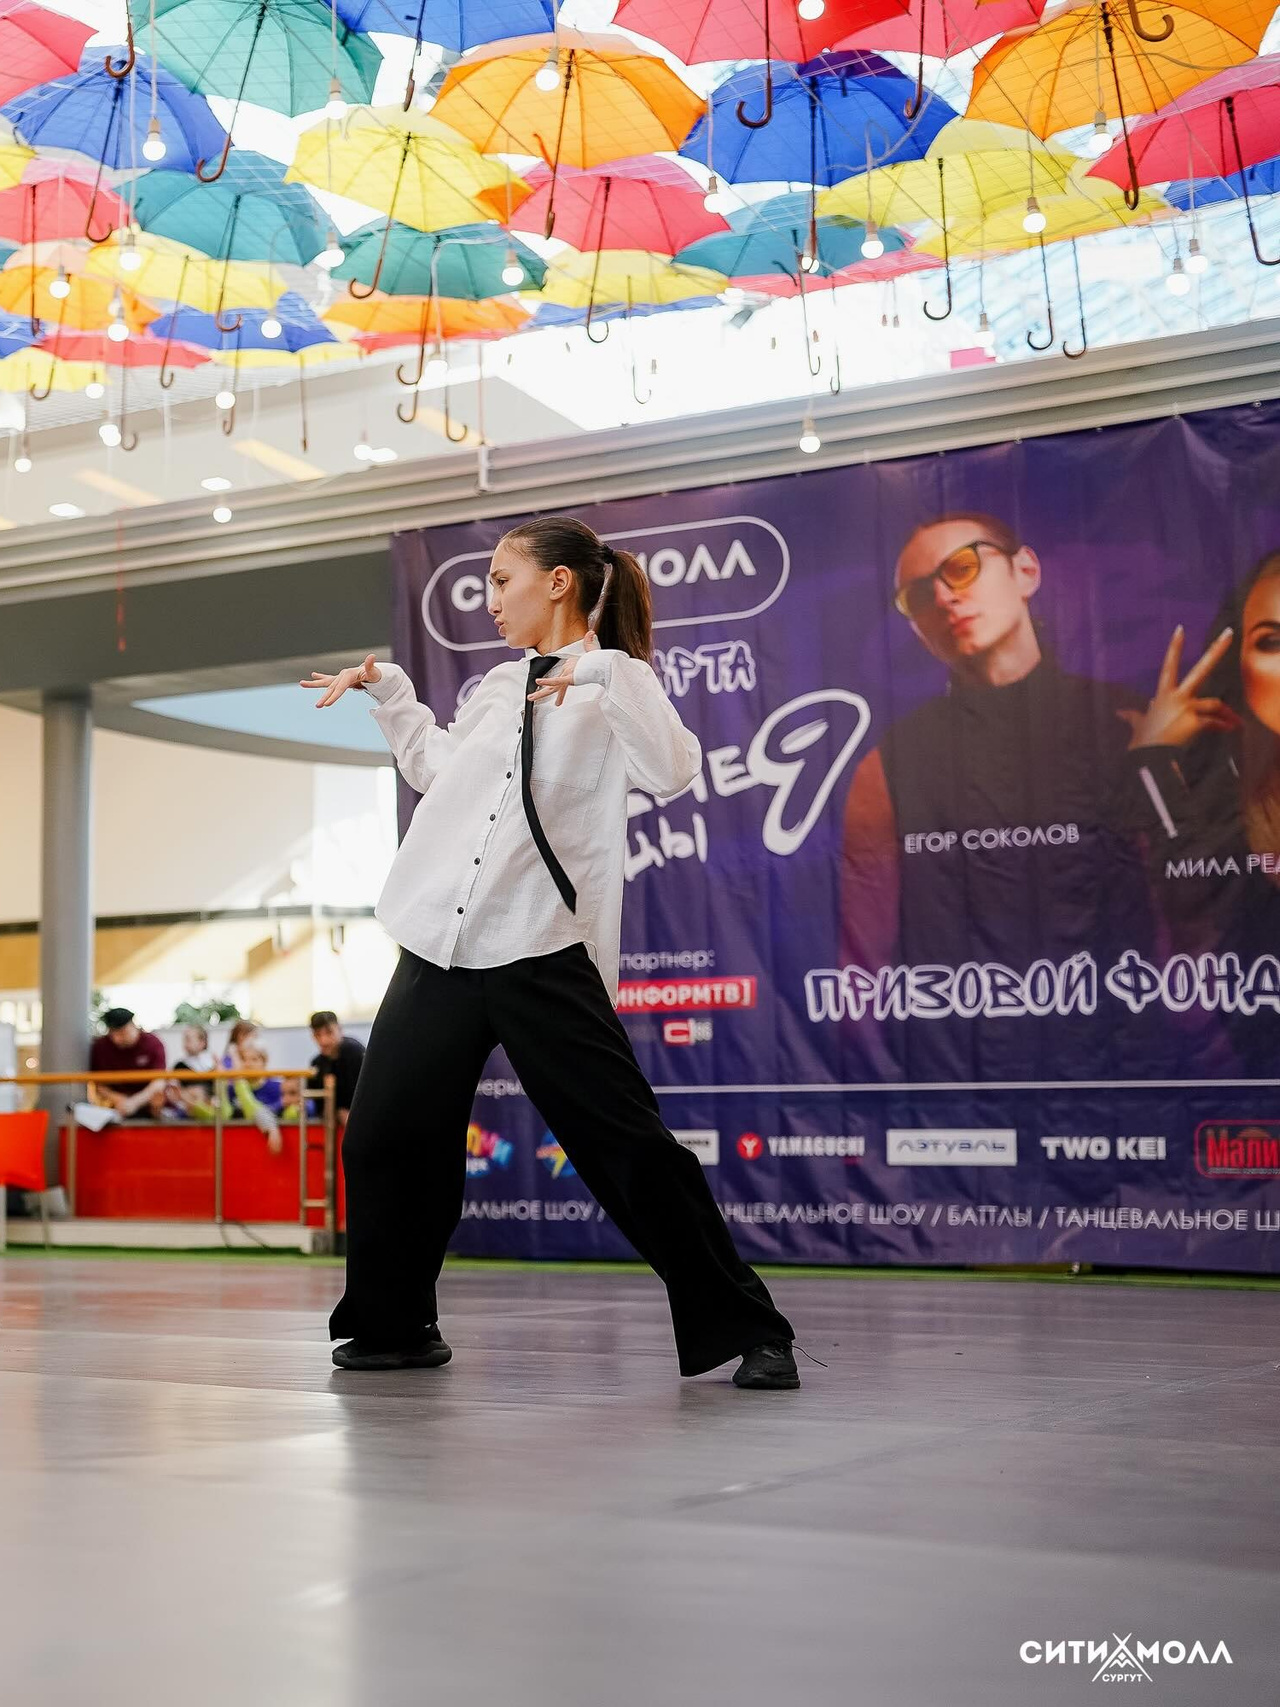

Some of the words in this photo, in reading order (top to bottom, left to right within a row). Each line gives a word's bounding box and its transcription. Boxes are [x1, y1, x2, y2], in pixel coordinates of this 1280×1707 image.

[904, 831, 958, 854] ЕГОР
[962, 823, 1080, 850] СОКОЛОВ
[1164, 855, 1241, 879] МИЛА
[1246, 852, 1280, 874] РЕ
[804, 950, 1098, 1023] ПРИЗОВОЙ
[1105, 949, 1280, 1017] ФОНД
[767, 1136, 865, 1157] YAMAGUCHI
[1040, 1136, 1110, 1161] TWO
[1117, 1136, 1167, 1161] KEI
[545, 1200, 595, 1221] ШОУ
[869, 1203, 926, 1226] ШОУ
[947, 1204, 1033, 1227] БАТТЛЫ
[1054, 1206, 1248, 1231] ТАНЦЕВАЛЬНОЕ
